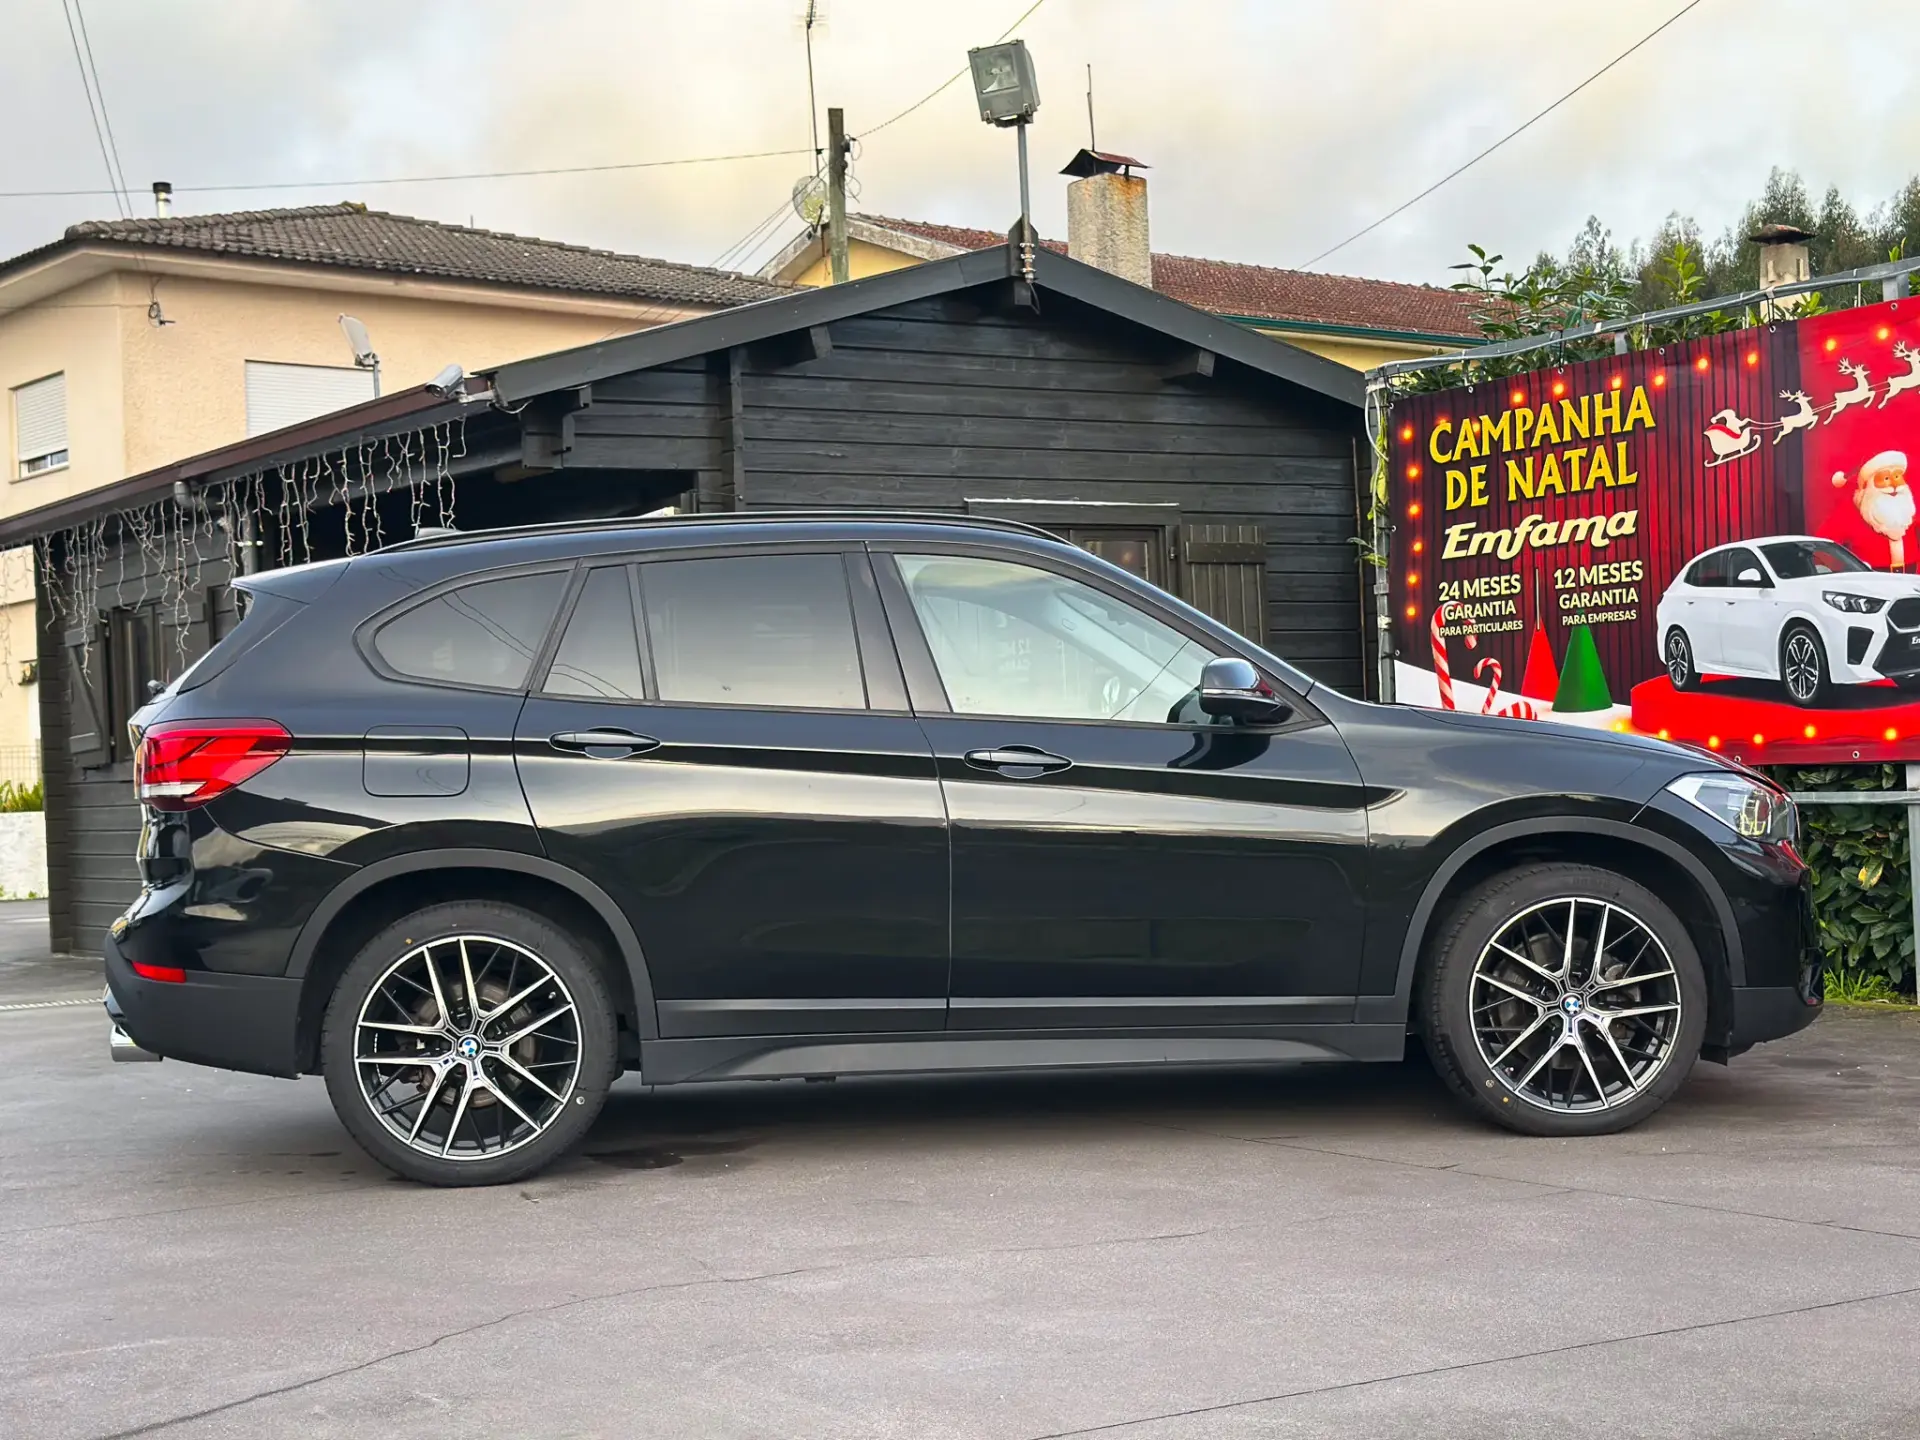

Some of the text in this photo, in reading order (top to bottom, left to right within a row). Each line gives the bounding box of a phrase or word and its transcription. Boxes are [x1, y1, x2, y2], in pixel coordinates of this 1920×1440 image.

[1429, 385, 1656, 464] CAMPANHA
[1445, 441, 1638, 511] DE NATAL
[1441, 509, 1639, 560] Emfama
[1438, 574, 1521, 602] 24 MESES
[1553, 560, 1643, 590] 12 MESES
[1444, 599, 1516, 621] GARANTIA
[1559, 587, 1639, 610] GARANTIA
[1439, 620, 1524, 637] PARA PARTICULARES
[1562, 609, 1637, 626] PARA EMPRESAS
